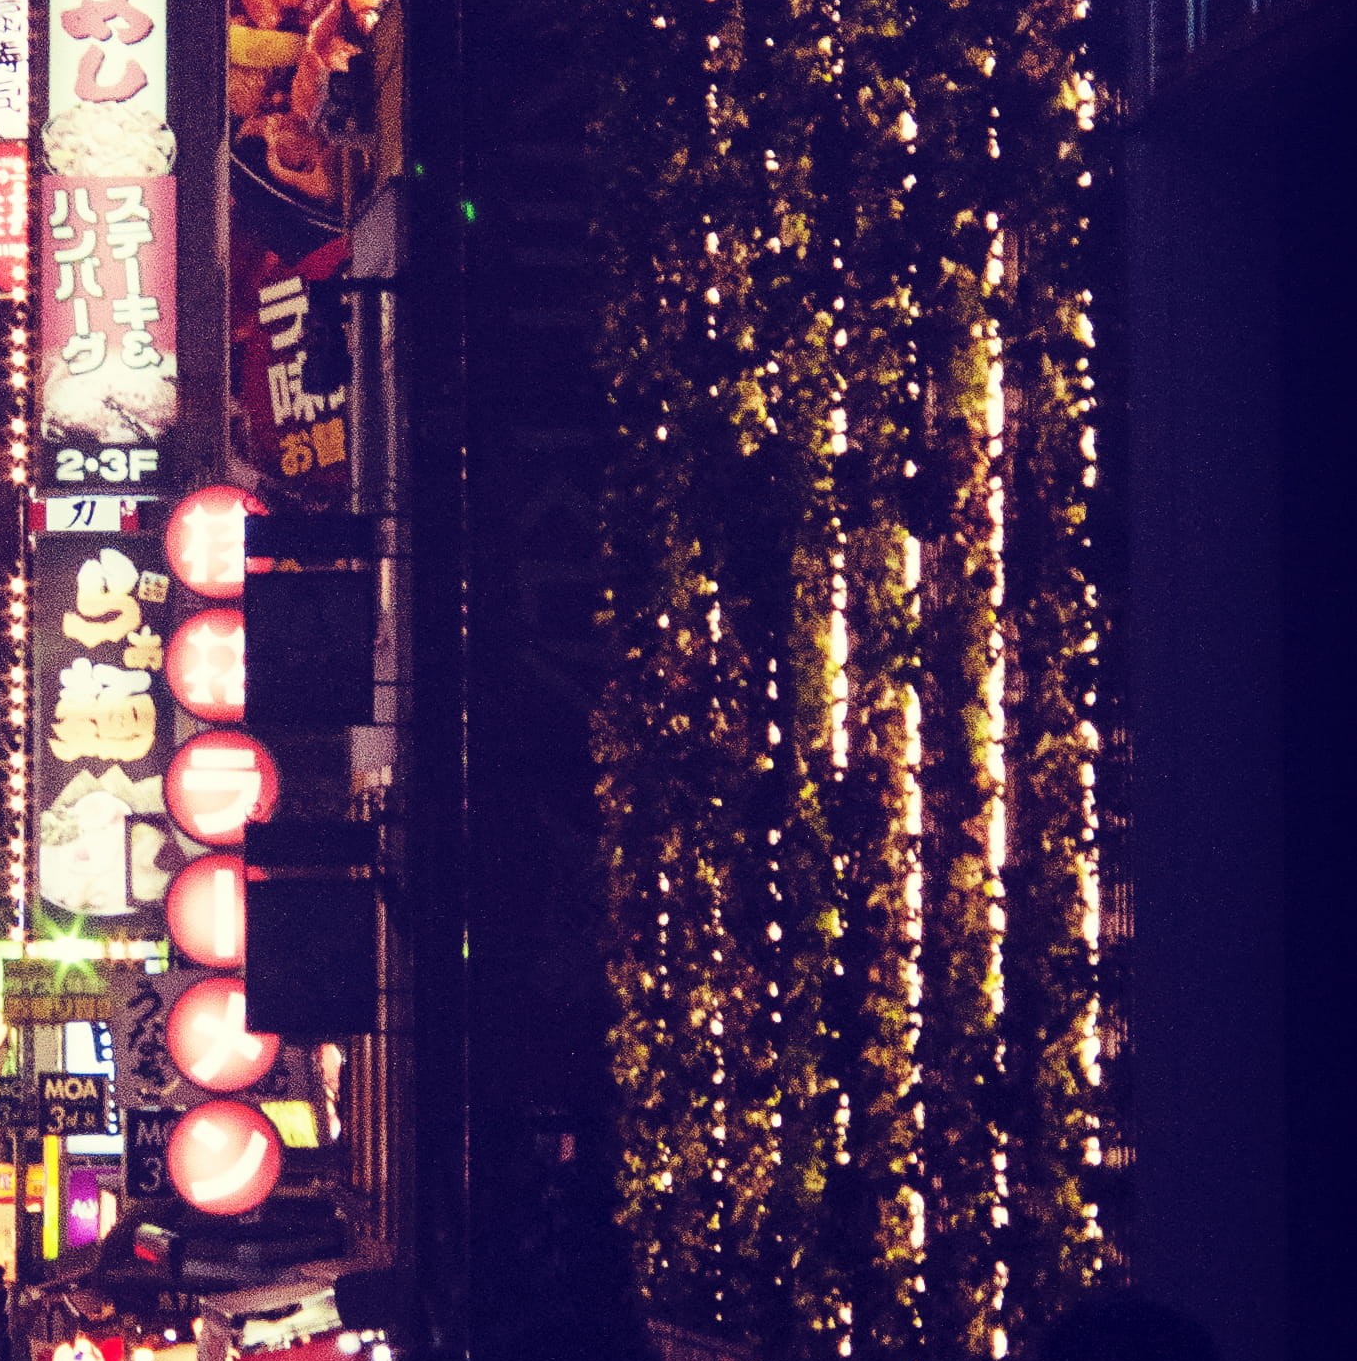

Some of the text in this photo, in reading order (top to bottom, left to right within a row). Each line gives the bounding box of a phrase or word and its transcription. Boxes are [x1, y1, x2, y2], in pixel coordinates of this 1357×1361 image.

[49, 187, 107, 376] ハンバーグ
[44, 1077, 98, 1101] MOA
